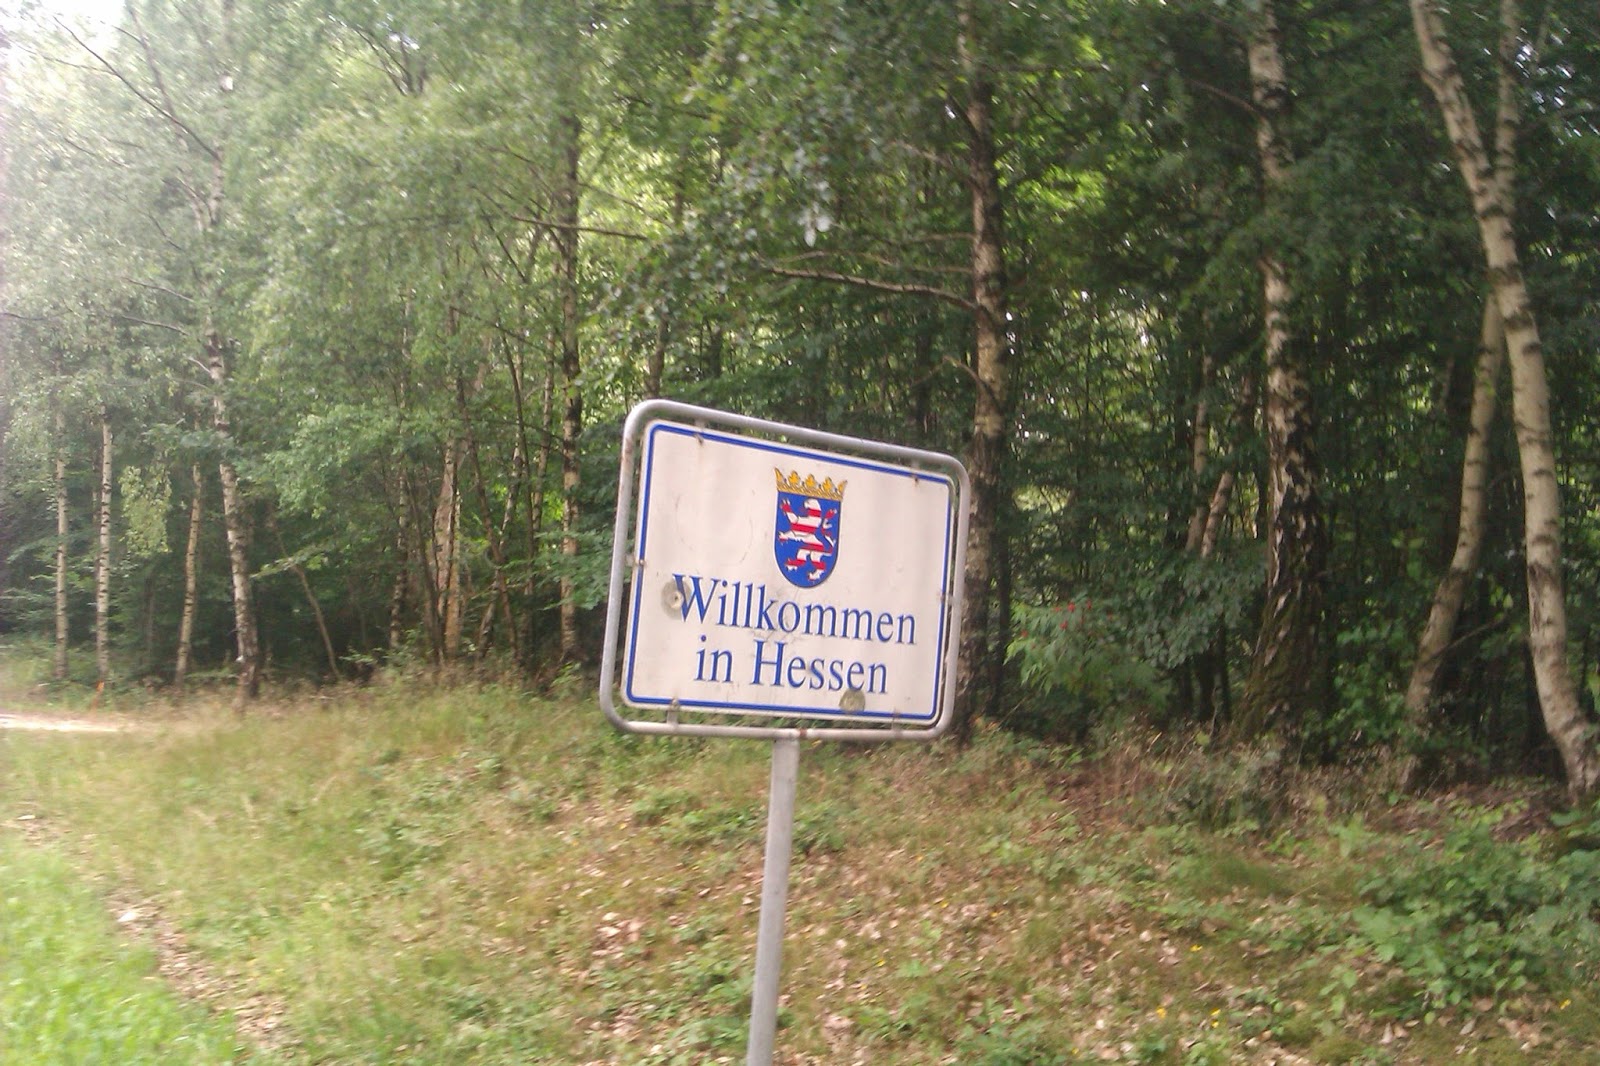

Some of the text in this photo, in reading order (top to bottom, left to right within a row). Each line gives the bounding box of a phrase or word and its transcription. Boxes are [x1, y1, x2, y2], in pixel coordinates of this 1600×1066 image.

[673, 574, 916, 645] Willkommen
[694, 635, 888, 694] in Hessen
